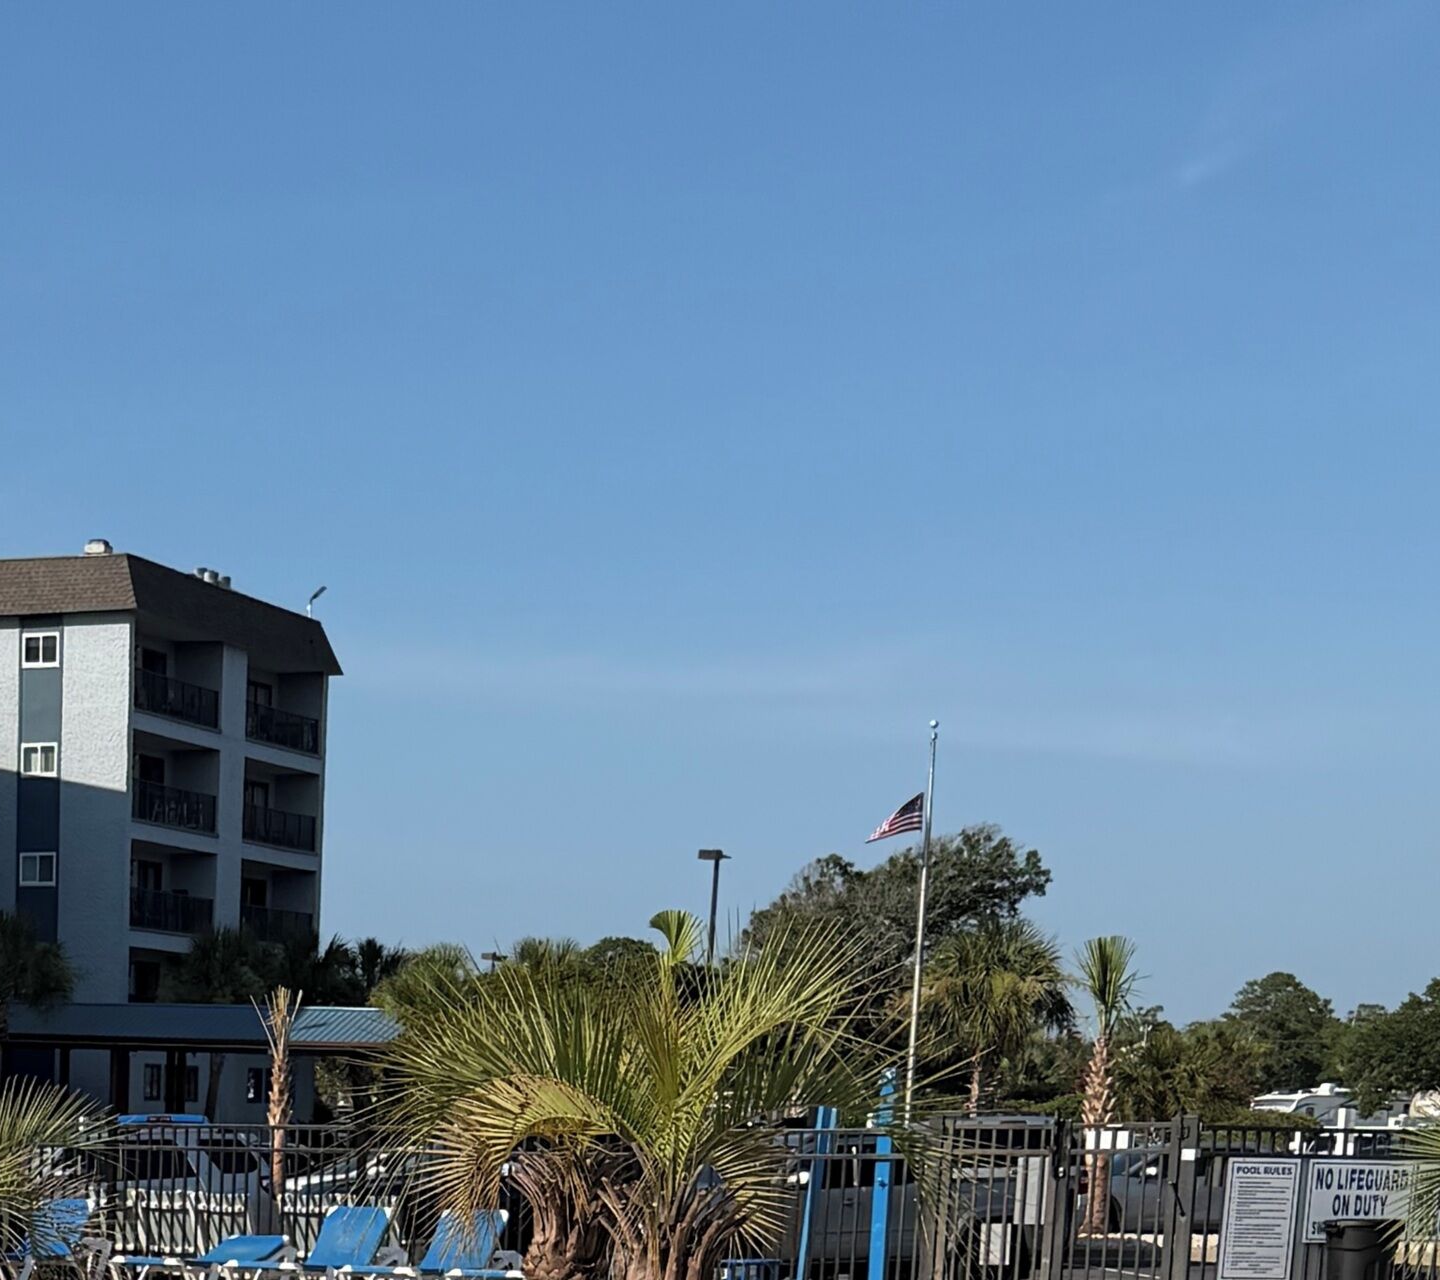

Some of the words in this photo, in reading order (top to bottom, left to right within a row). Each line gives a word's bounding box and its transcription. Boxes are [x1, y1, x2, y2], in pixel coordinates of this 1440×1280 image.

[1236, 1166, 1261, 1175] POOL
[1263, 1166, 1292, 1175] RULES
[1315, 1167, 1334, 1190] NO
[1337, 1168, 1408, 1191] LIFEGUARD
[1332, 1194, 1350, 1216] ON
[1354, 1194, 1388, 1216] DUTY
